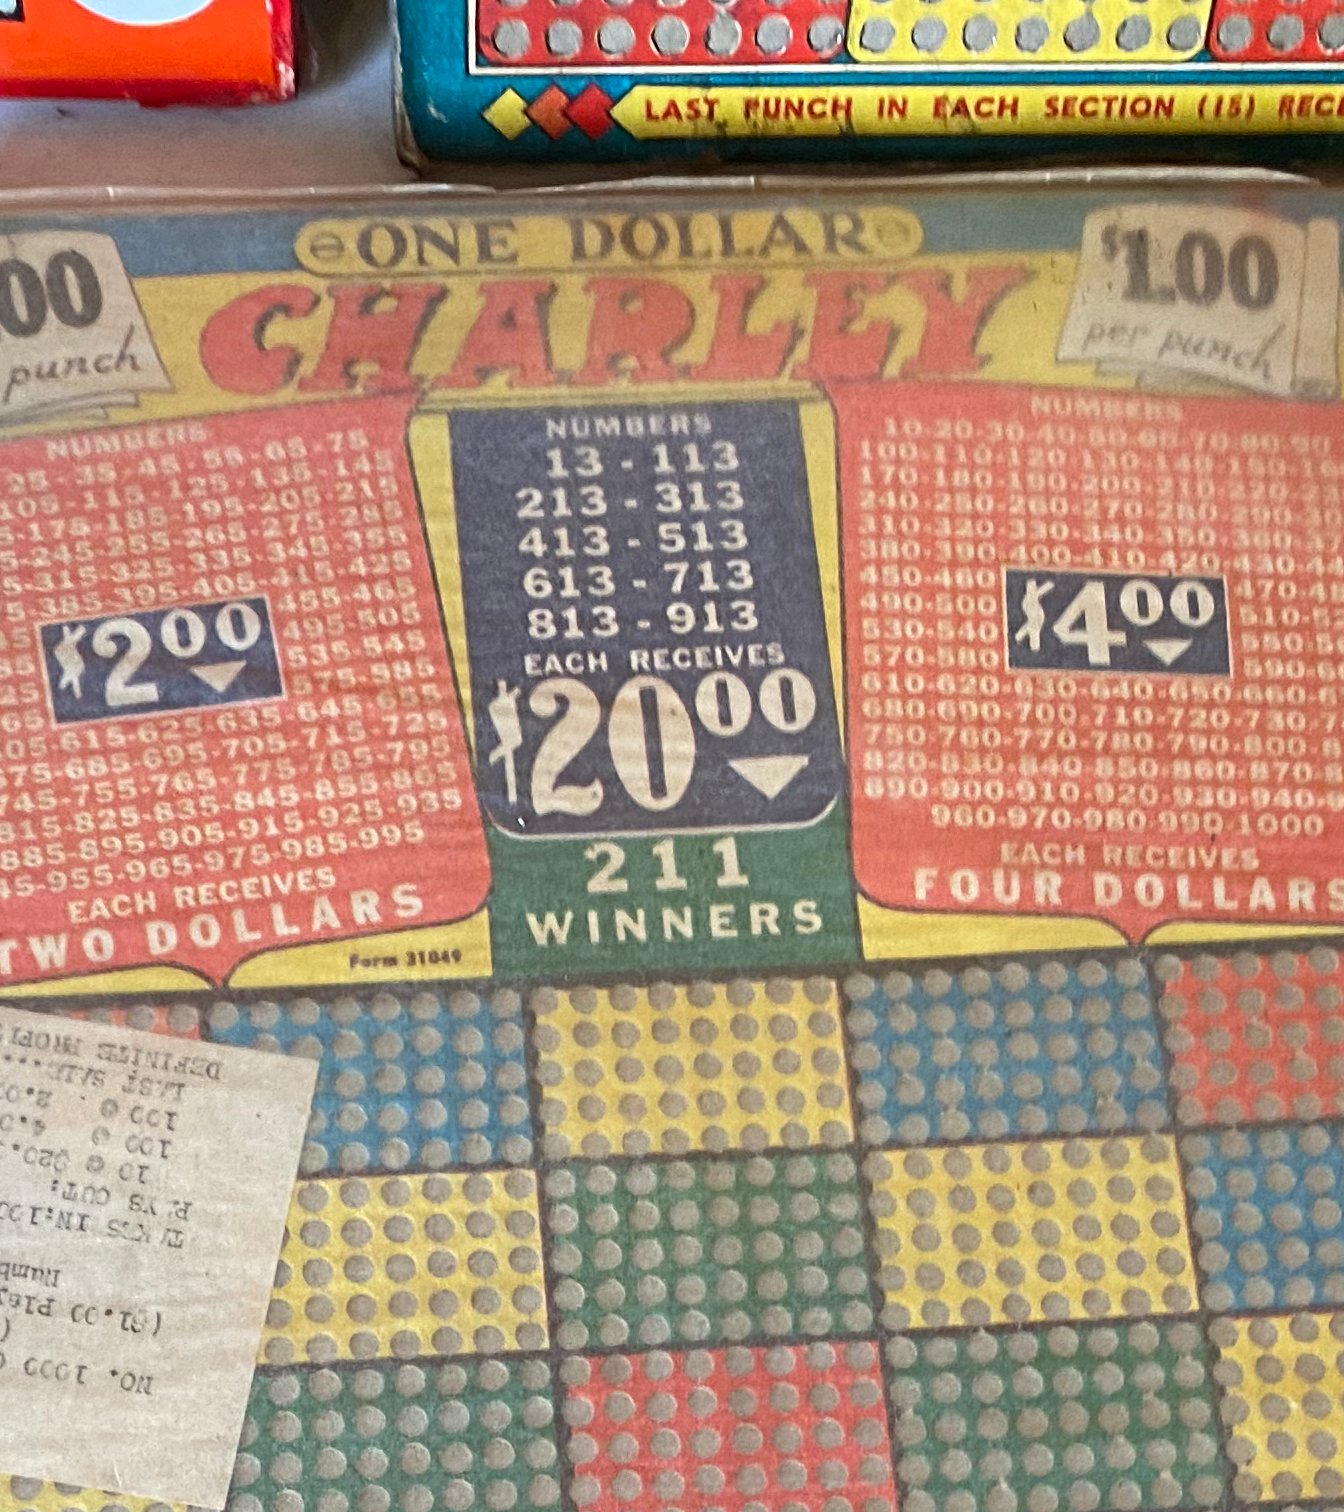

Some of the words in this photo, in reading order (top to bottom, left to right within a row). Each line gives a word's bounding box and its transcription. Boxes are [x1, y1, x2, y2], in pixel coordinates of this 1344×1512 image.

[645, 97, 718, 122] LAST
[743, 96, 853, 122] PUNCH
[877, 96, 908, 120] IN
[932, 96, 1020, 120] EACH
[1043, 95, 1175, 120] SECTION
[357, 220, 518, 269] ONE
[572, 213, 862, 261] DOLLAR
[1101, 224, 1280, 310] $1.00
[200, 264, 1038, 393] CHARLEY
[5, 325, 142, 404] punch
[1083, 324, 1140, 354] per
[1158, 321, 1288, 382] punch
[545, 412, 712, 440] NUMBERS
[1030, 396, 1183, 422] NUMBERS
[46, 425, 208, 458] NUMBERS
[546, 446, 603, 478] 13
[653, 440, 739, 473] 113
[516, 485, 607, 518] 213
[656, 480, 745, 513] 313
[519, 526, 610, 558] 413
[657, 520, 748, 554] 513
[523, 567, 615, 599] 613
[664, 560, 754, 595] 713
[527, 605, 619, 640] 813
[666, 600, 759, 635] 913
[524, 650, 608, 677] EACH
[630, 643, 786, 672] RECEIVES
[1000, 841, 1086, 866] EACH
[1103, 843, 1260, 871] RECEIVES
[68, 892, 156, 924] EACH
[174, 866, 336, 907] RECEIVES
[913, 868, 1062, 907] FOUR
[146, 884, 425, 956] DOLLARS
[526, 900, 824, 947] WINNERS
